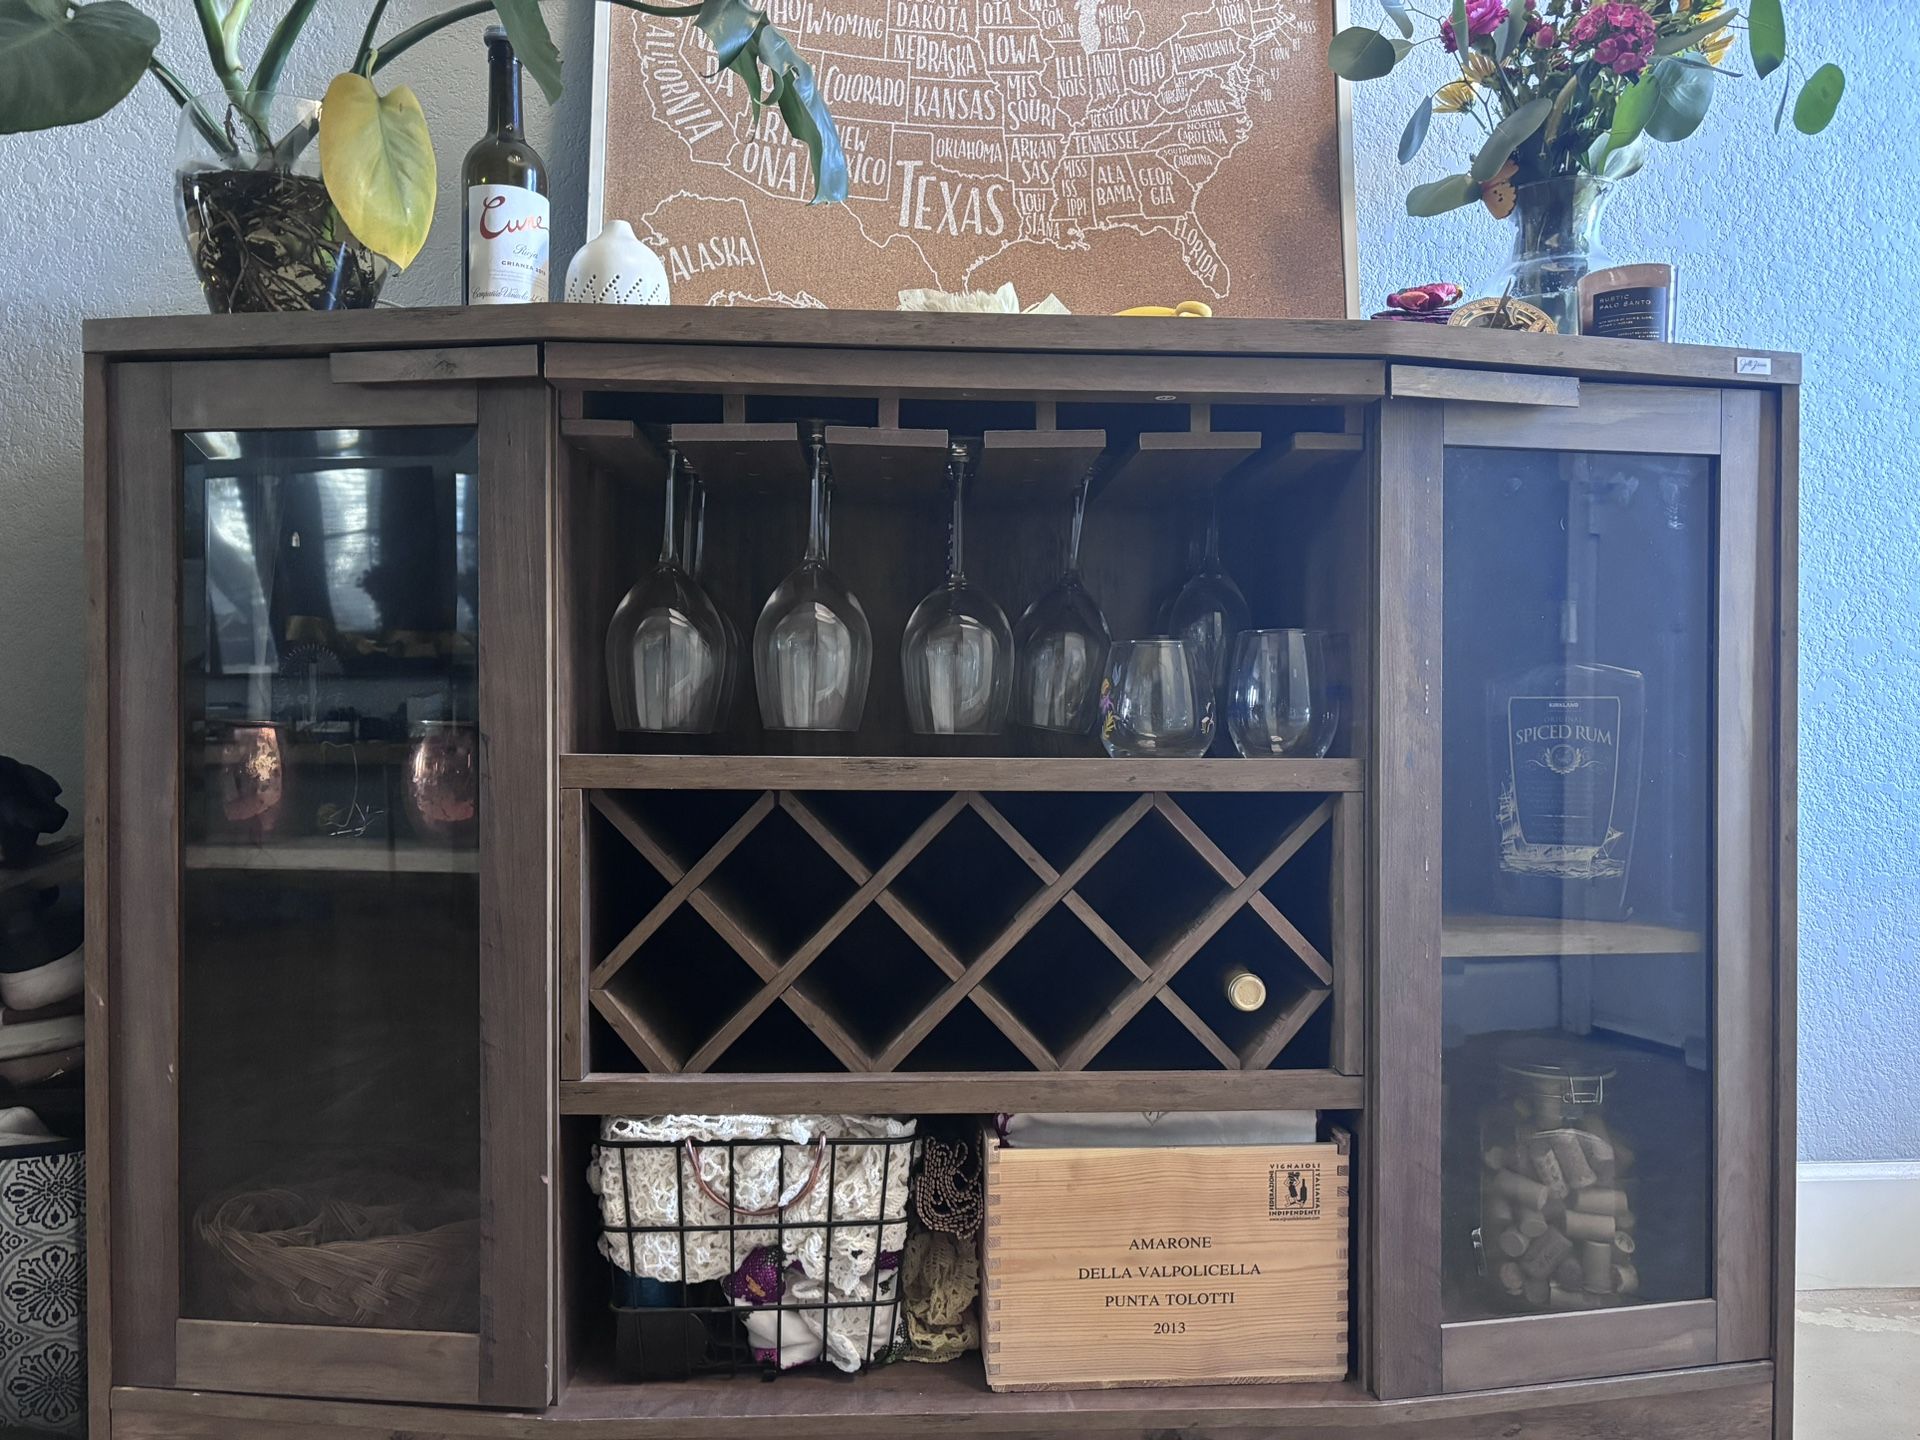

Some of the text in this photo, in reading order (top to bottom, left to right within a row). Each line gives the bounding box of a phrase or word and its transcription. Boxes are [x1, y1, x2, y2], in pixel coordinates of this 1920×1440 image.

[806, 3, 884, 39] WYOMING
[896, 2, 968, 32] DAKOTA
[983, 1, 1013, 25] OTA
[1042, 8, 1064, 29] CON
[1099, 4, 1125, 27] MICH
[1216, 3, 1246, 27] YORK
[1057, 23, 1074, 39] SIN
[1104, 24, 1130, 46] IGAN
[1296, 20, 1317, 35] MASS
[894, 33, 978, 79] NEBRASKA
[988, 32, 1041, 65] IOWA
[1270, 47, 1290, 61] CONN
[1055, 56, 1084, 80] ILLI
[1092, 52, 1117, 78] INDI
[1129, 51, 1165, 87] OHIO
[823, 65, 906, 107] COLORADO
[1007, 74, 1038, 100] MIS
[1057, 77, 1086, 98] NOIS
[1095, 75, 1120, 97] ANA
[913, 85, 997, 121] KANSAS
[1090, 98, 1151, 128] KENTUCKY
[1185, 99, 1228, 119] VIRGINIA
[1007, 99, 1057, 131] SOURI
[1186, 120, 1221, 131] NORTH
[1073, 130, 1141, 154] TENNESSEE
[1178, 127, 1229, 144] CAROLINA
[936, 138, 1003, 164] OKLAHOMA
[1010, 137, 1057, 163] ARKAN
[742, 141, 796, 193] ONA
[1022, 160, 1050, 185] SAS
[1063, 160, 1087, 178] MISS
[1173, 154, 1213, 169] CAROLINA
[1098, 166, 1126, 184] ALA
[1138, 167, 1174, 187] GEOR
[896, 160, 1004, 236] TEXAS
[1061, 179, 1078, 198] ISS
[1096, 184, 1136, 206] BAMA
[1150, 187, 1176, 206] GIA
[1067, 197, 1087, 217] IPPI
[1025, 213, 1060, 239] SIANA
[513, 244, 539, 260] Rioja
[669, 236, 756, 284] ALASKA
[1174, 218, 1219, 282] FLORIDA
[501, 260, 534, 271] CRIANZA
[1600, 294, 1629, 303] RUSTIC
[1600, 299, 1651, 310] PALO SANTO
[1516, 724, 1612, 746] SPICED RUM
[1129, 1236, 1212, 1250] AMARONE
[1078, 1263, 1261, 1280] DELLA VALPOLICELLA
[1105, 1292, 1235, 1307] PUNTA TOLOTTI
[1153, 1322, 1186, 1334] 2013
